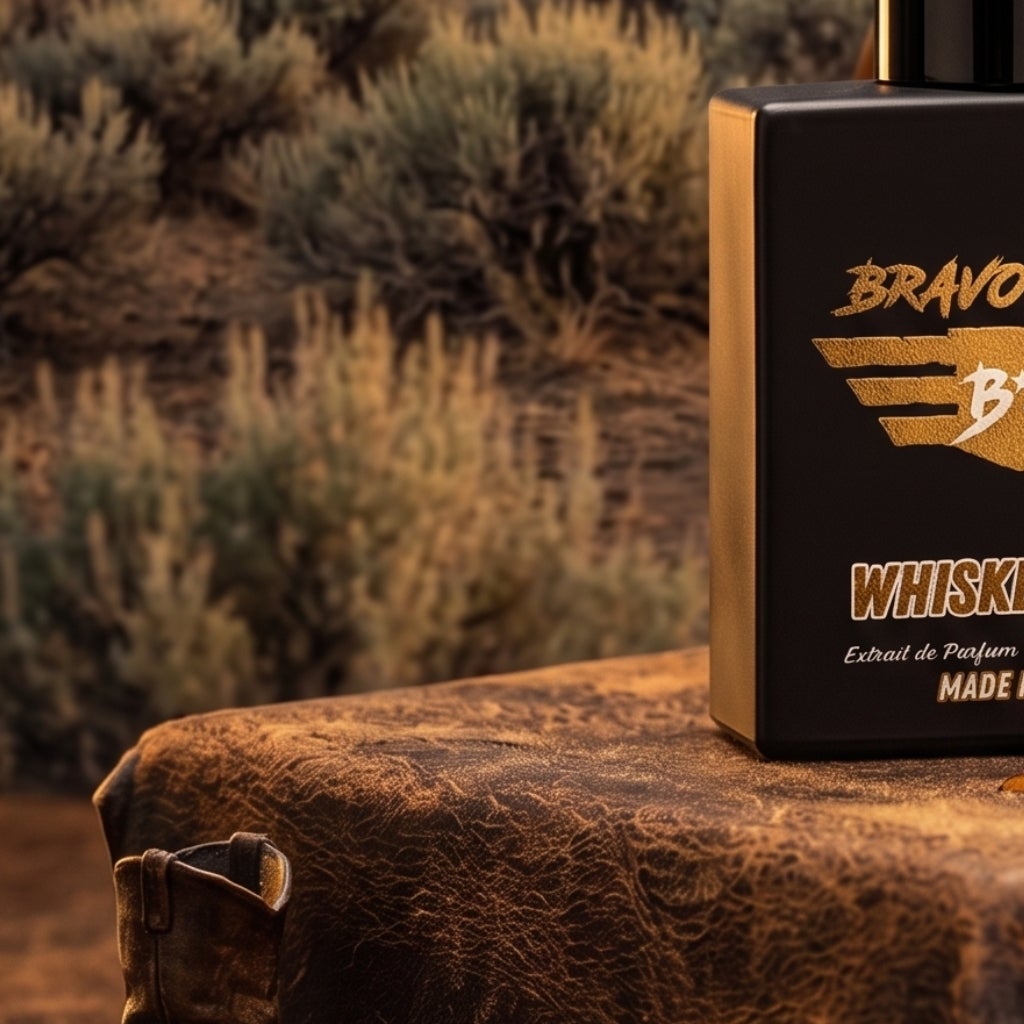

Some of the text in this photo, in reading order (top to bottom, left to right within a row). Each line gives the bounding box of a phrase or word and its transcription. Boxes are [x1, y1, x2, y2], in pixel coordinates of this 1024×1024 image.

[843, 644, 911, 664] Extrait
[914, 642, 938, 661] de
[943, 642, 1019, 667] Parfum
[936, 669, 1014, 703] MADE
